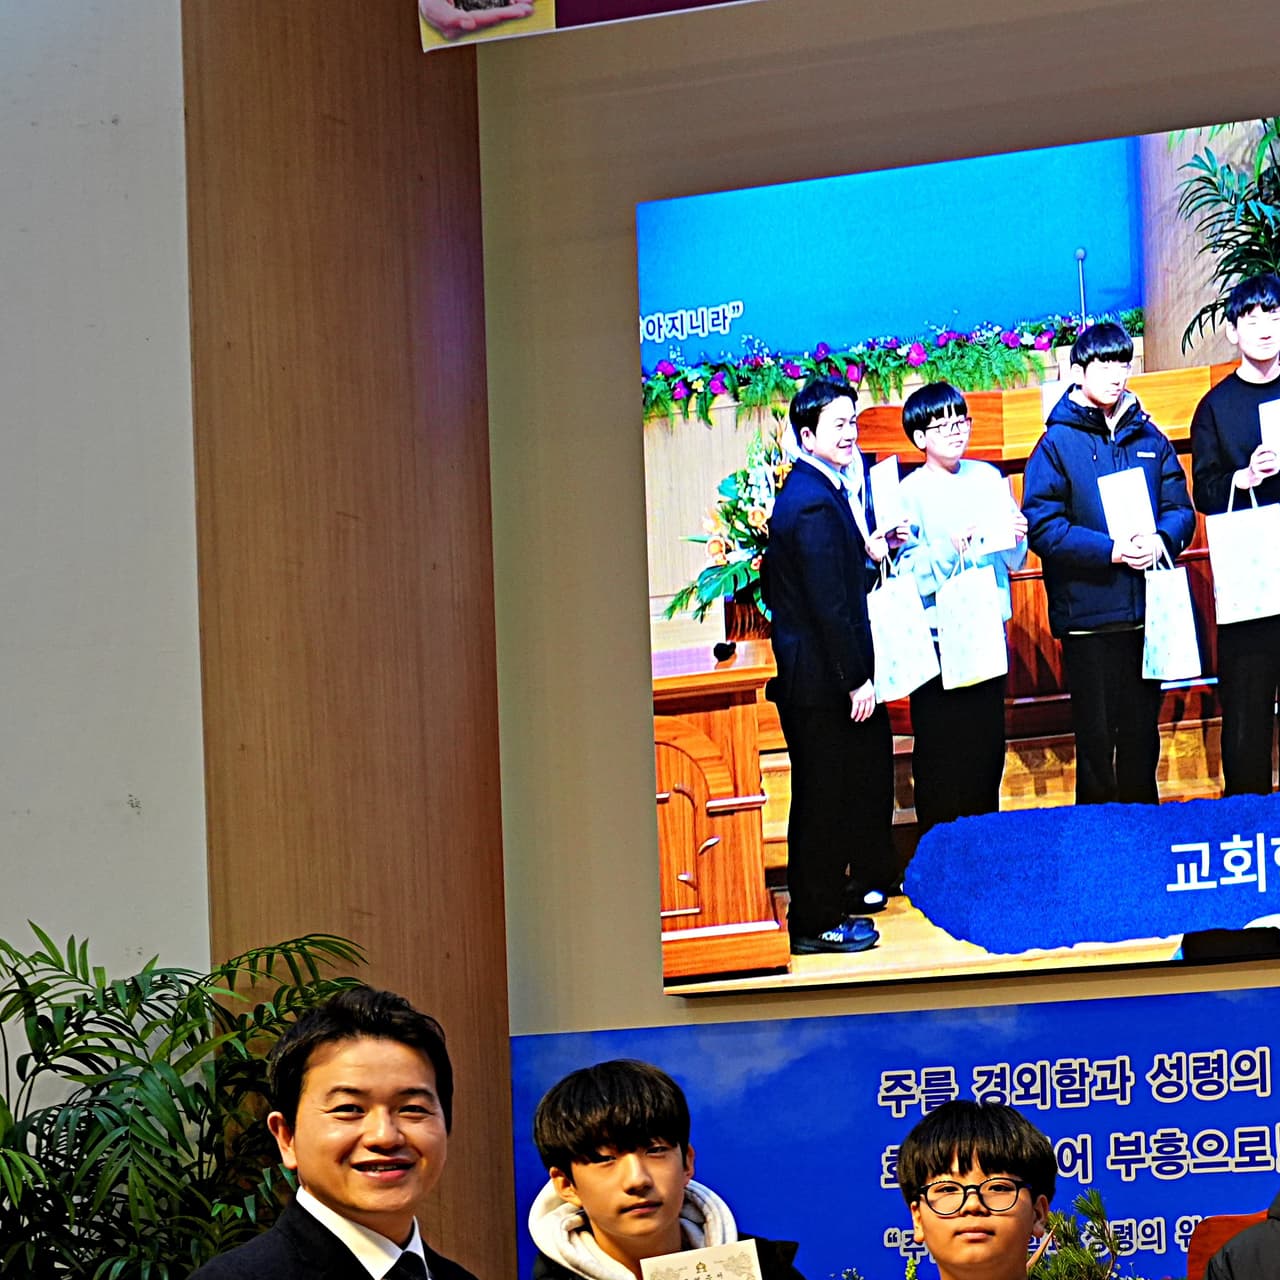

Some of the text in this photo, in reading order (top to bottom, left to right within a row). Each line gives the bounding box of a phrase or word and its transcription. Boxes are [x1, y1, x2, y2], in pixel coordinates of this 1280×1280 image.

[877, 1066, 959, 1118] 주를
[970, 1056, 1135, 1110] 경외함과
[1146, 1046, 1272, 1103] 성령의
